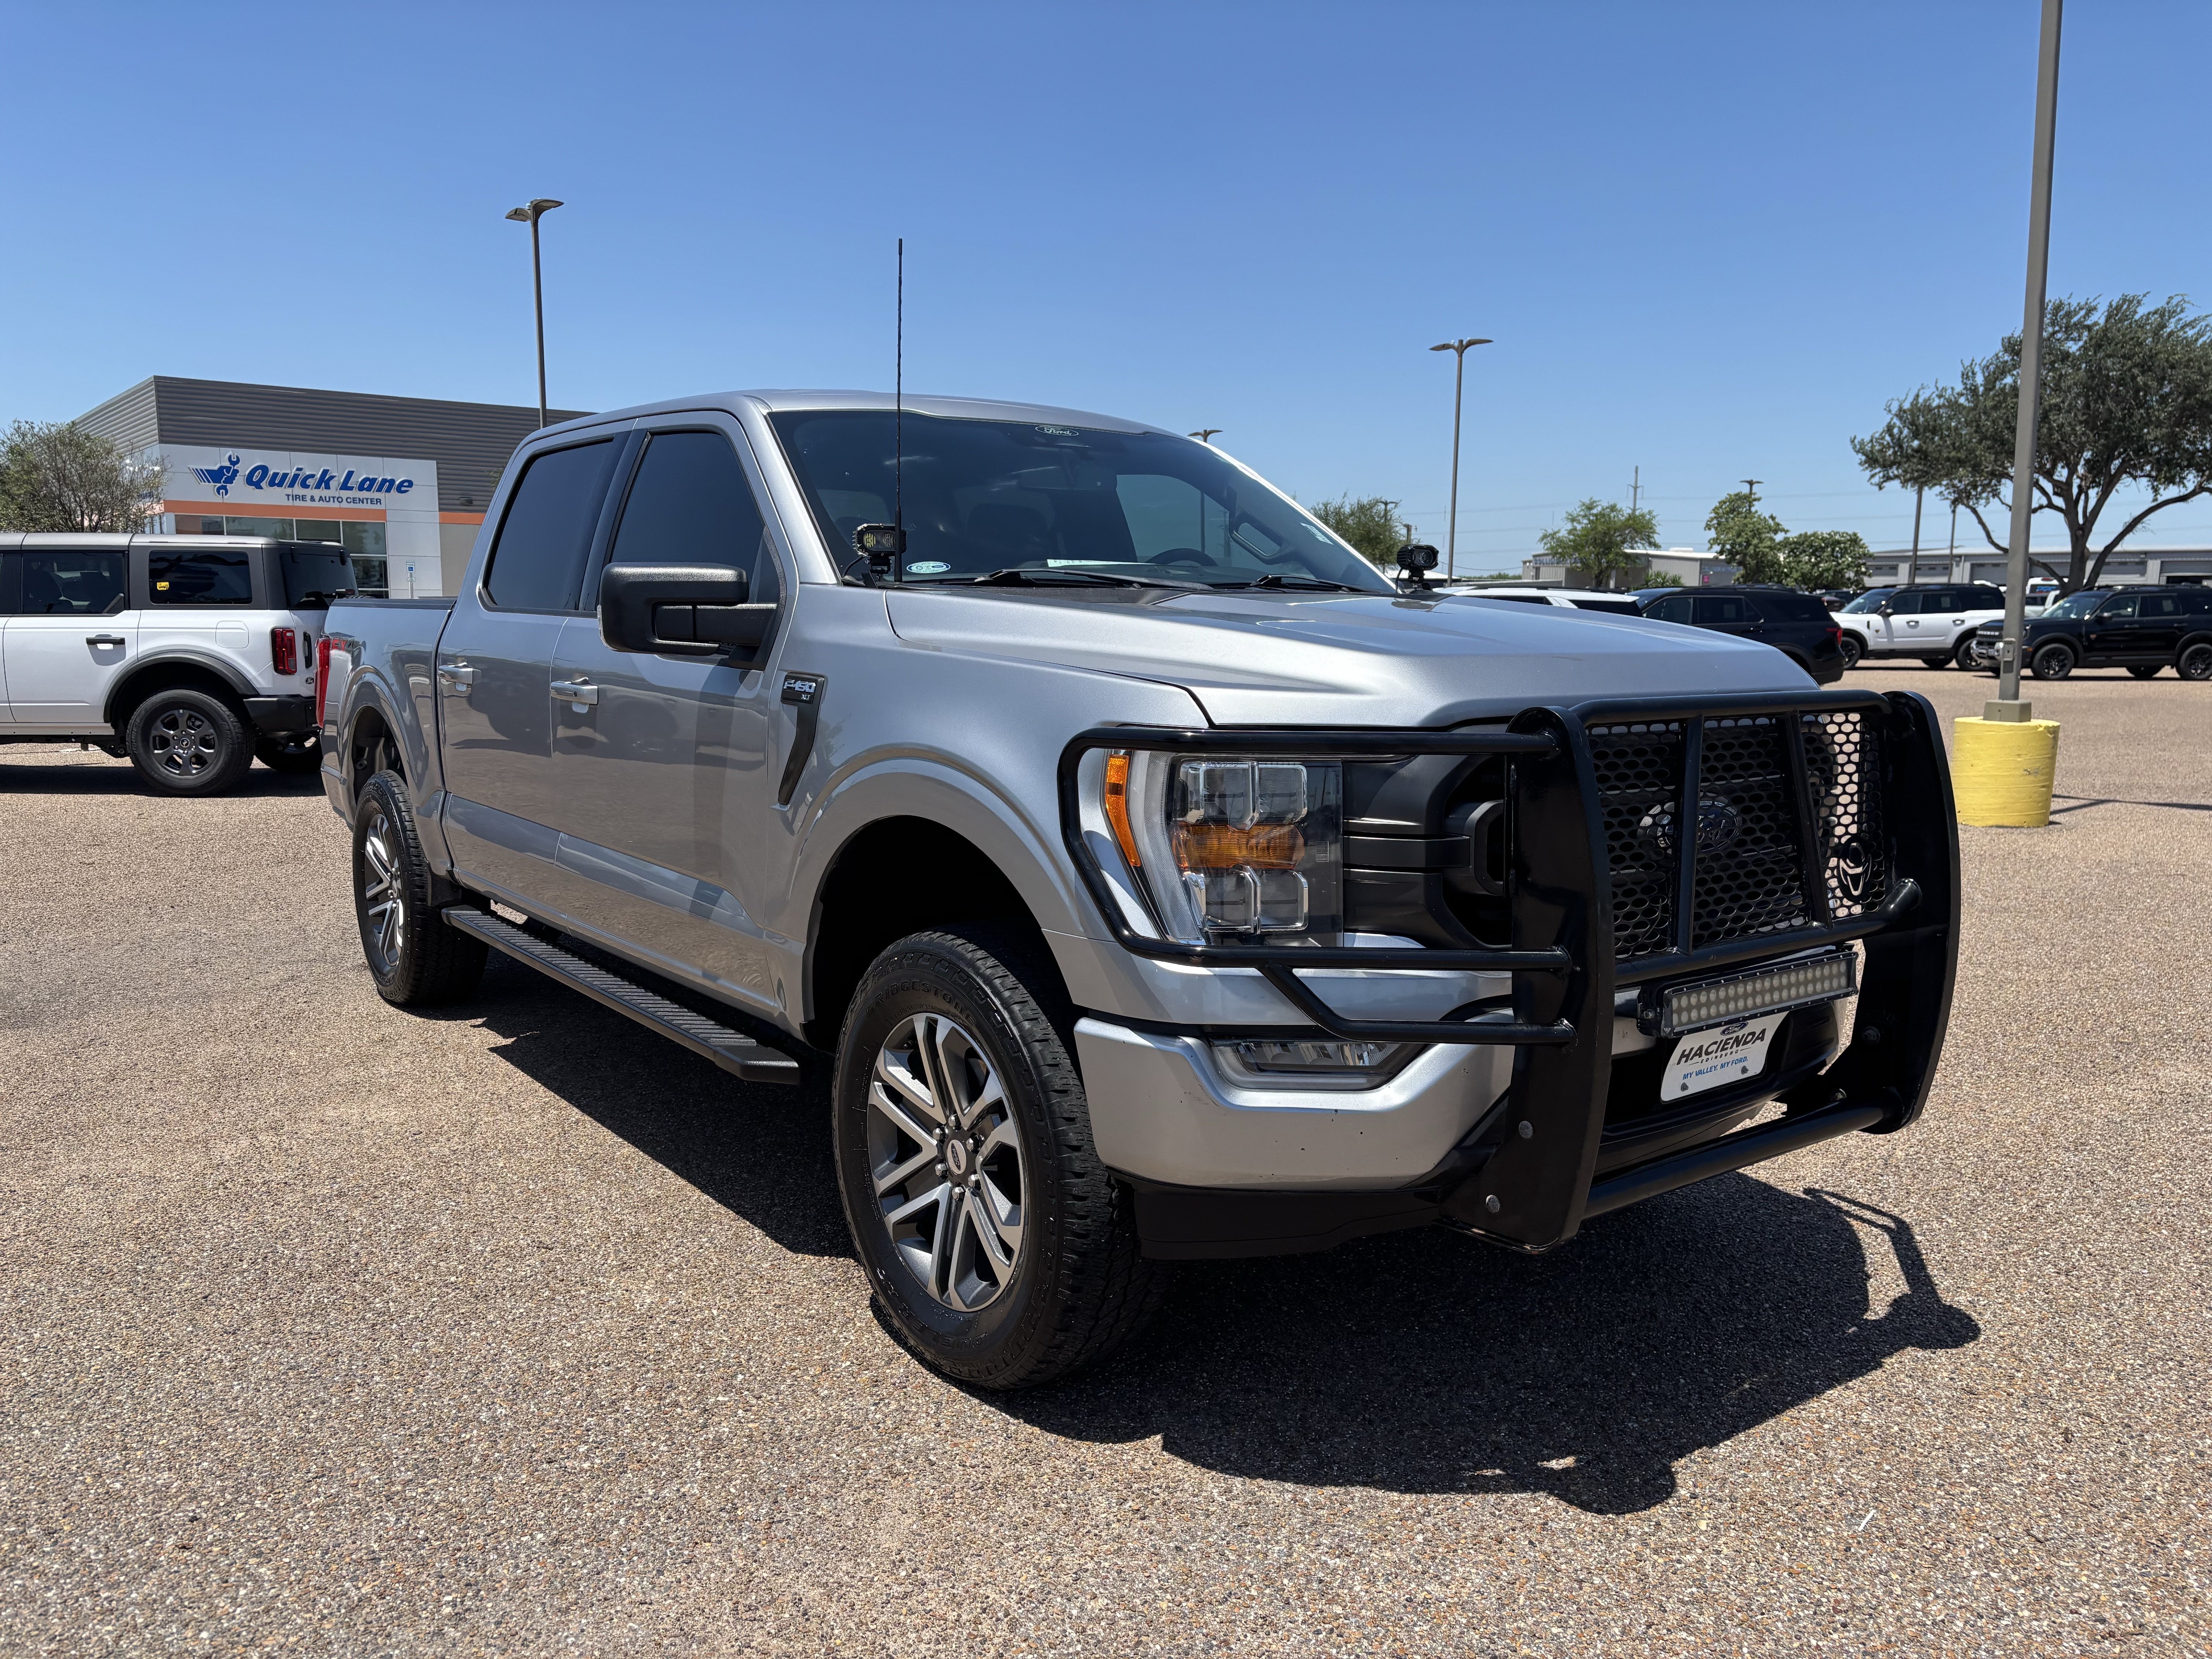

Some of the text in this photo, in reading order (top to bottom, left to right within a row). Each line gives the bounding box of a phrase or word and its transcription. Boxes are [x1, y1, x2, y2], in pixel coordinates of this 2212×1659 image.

[1044, 427, 1072, 435] Ford
[245, 465, 414, 494] Quick Lane
[285, 494, 307, 502] TIRE
[318, 495, 344, 503] AUTO
[346, 496, 382, 505] CENTER
[1677, 1028, 1767, 1065] HACIENDA
[1700, 1049, 1738, 1063] EDINBURG
[1683, 1071, 1695, 1080] MY
[1720, 1061, 1731, 1070] MY
